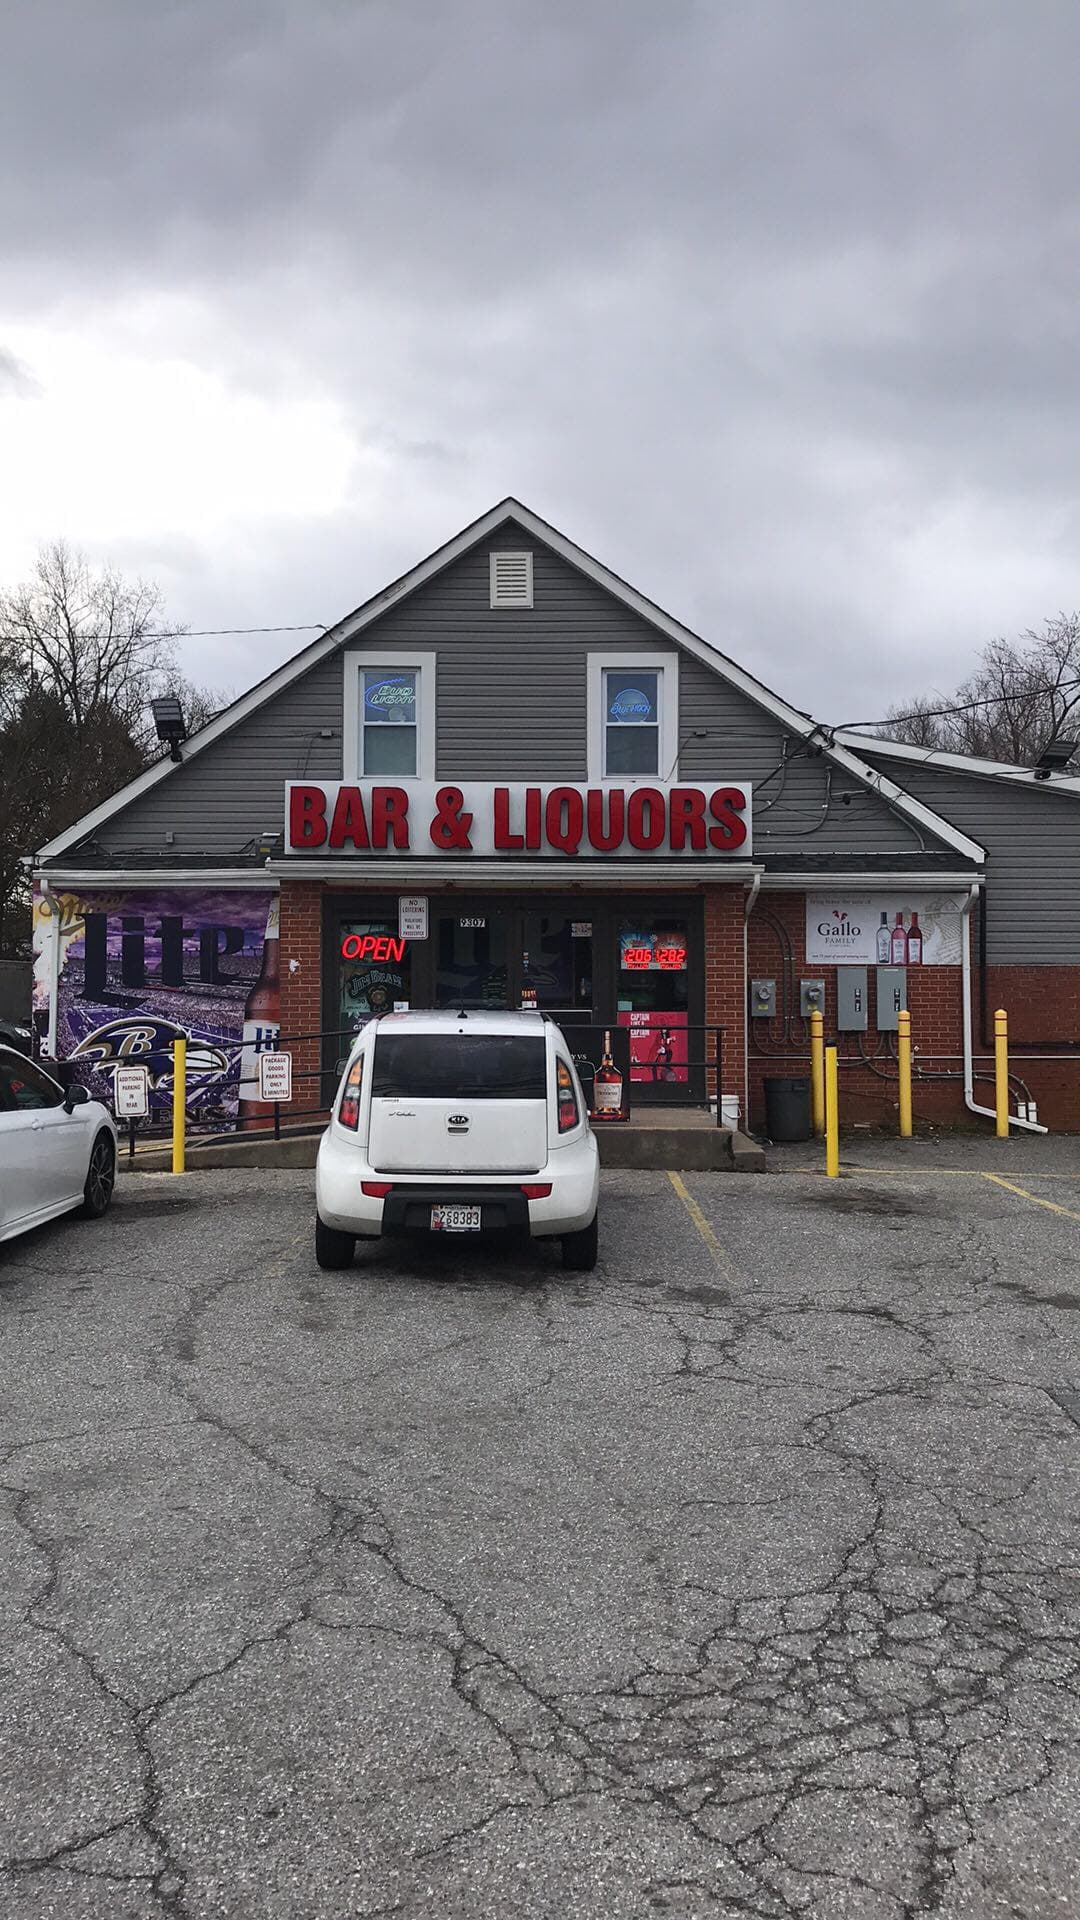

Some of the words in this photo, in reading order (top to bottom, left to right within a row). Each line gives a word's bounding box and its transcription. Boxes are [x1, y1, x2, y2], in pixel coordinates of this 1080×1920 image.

[290, 786, 410, 849] BAR
[429, 787, 474, 849] &
[494, 787, 747, 855] LIQUORS
[460, 918, 485, 927] 9307
[817, 922, 861, 936] Gallo
[341, 934, 406, 962] OPEN
[75, 912, 245, 1009] Lite
[630, 1013, 650, 1021] CAPTAIN
[450, 1116, 467, 1124] KIA
